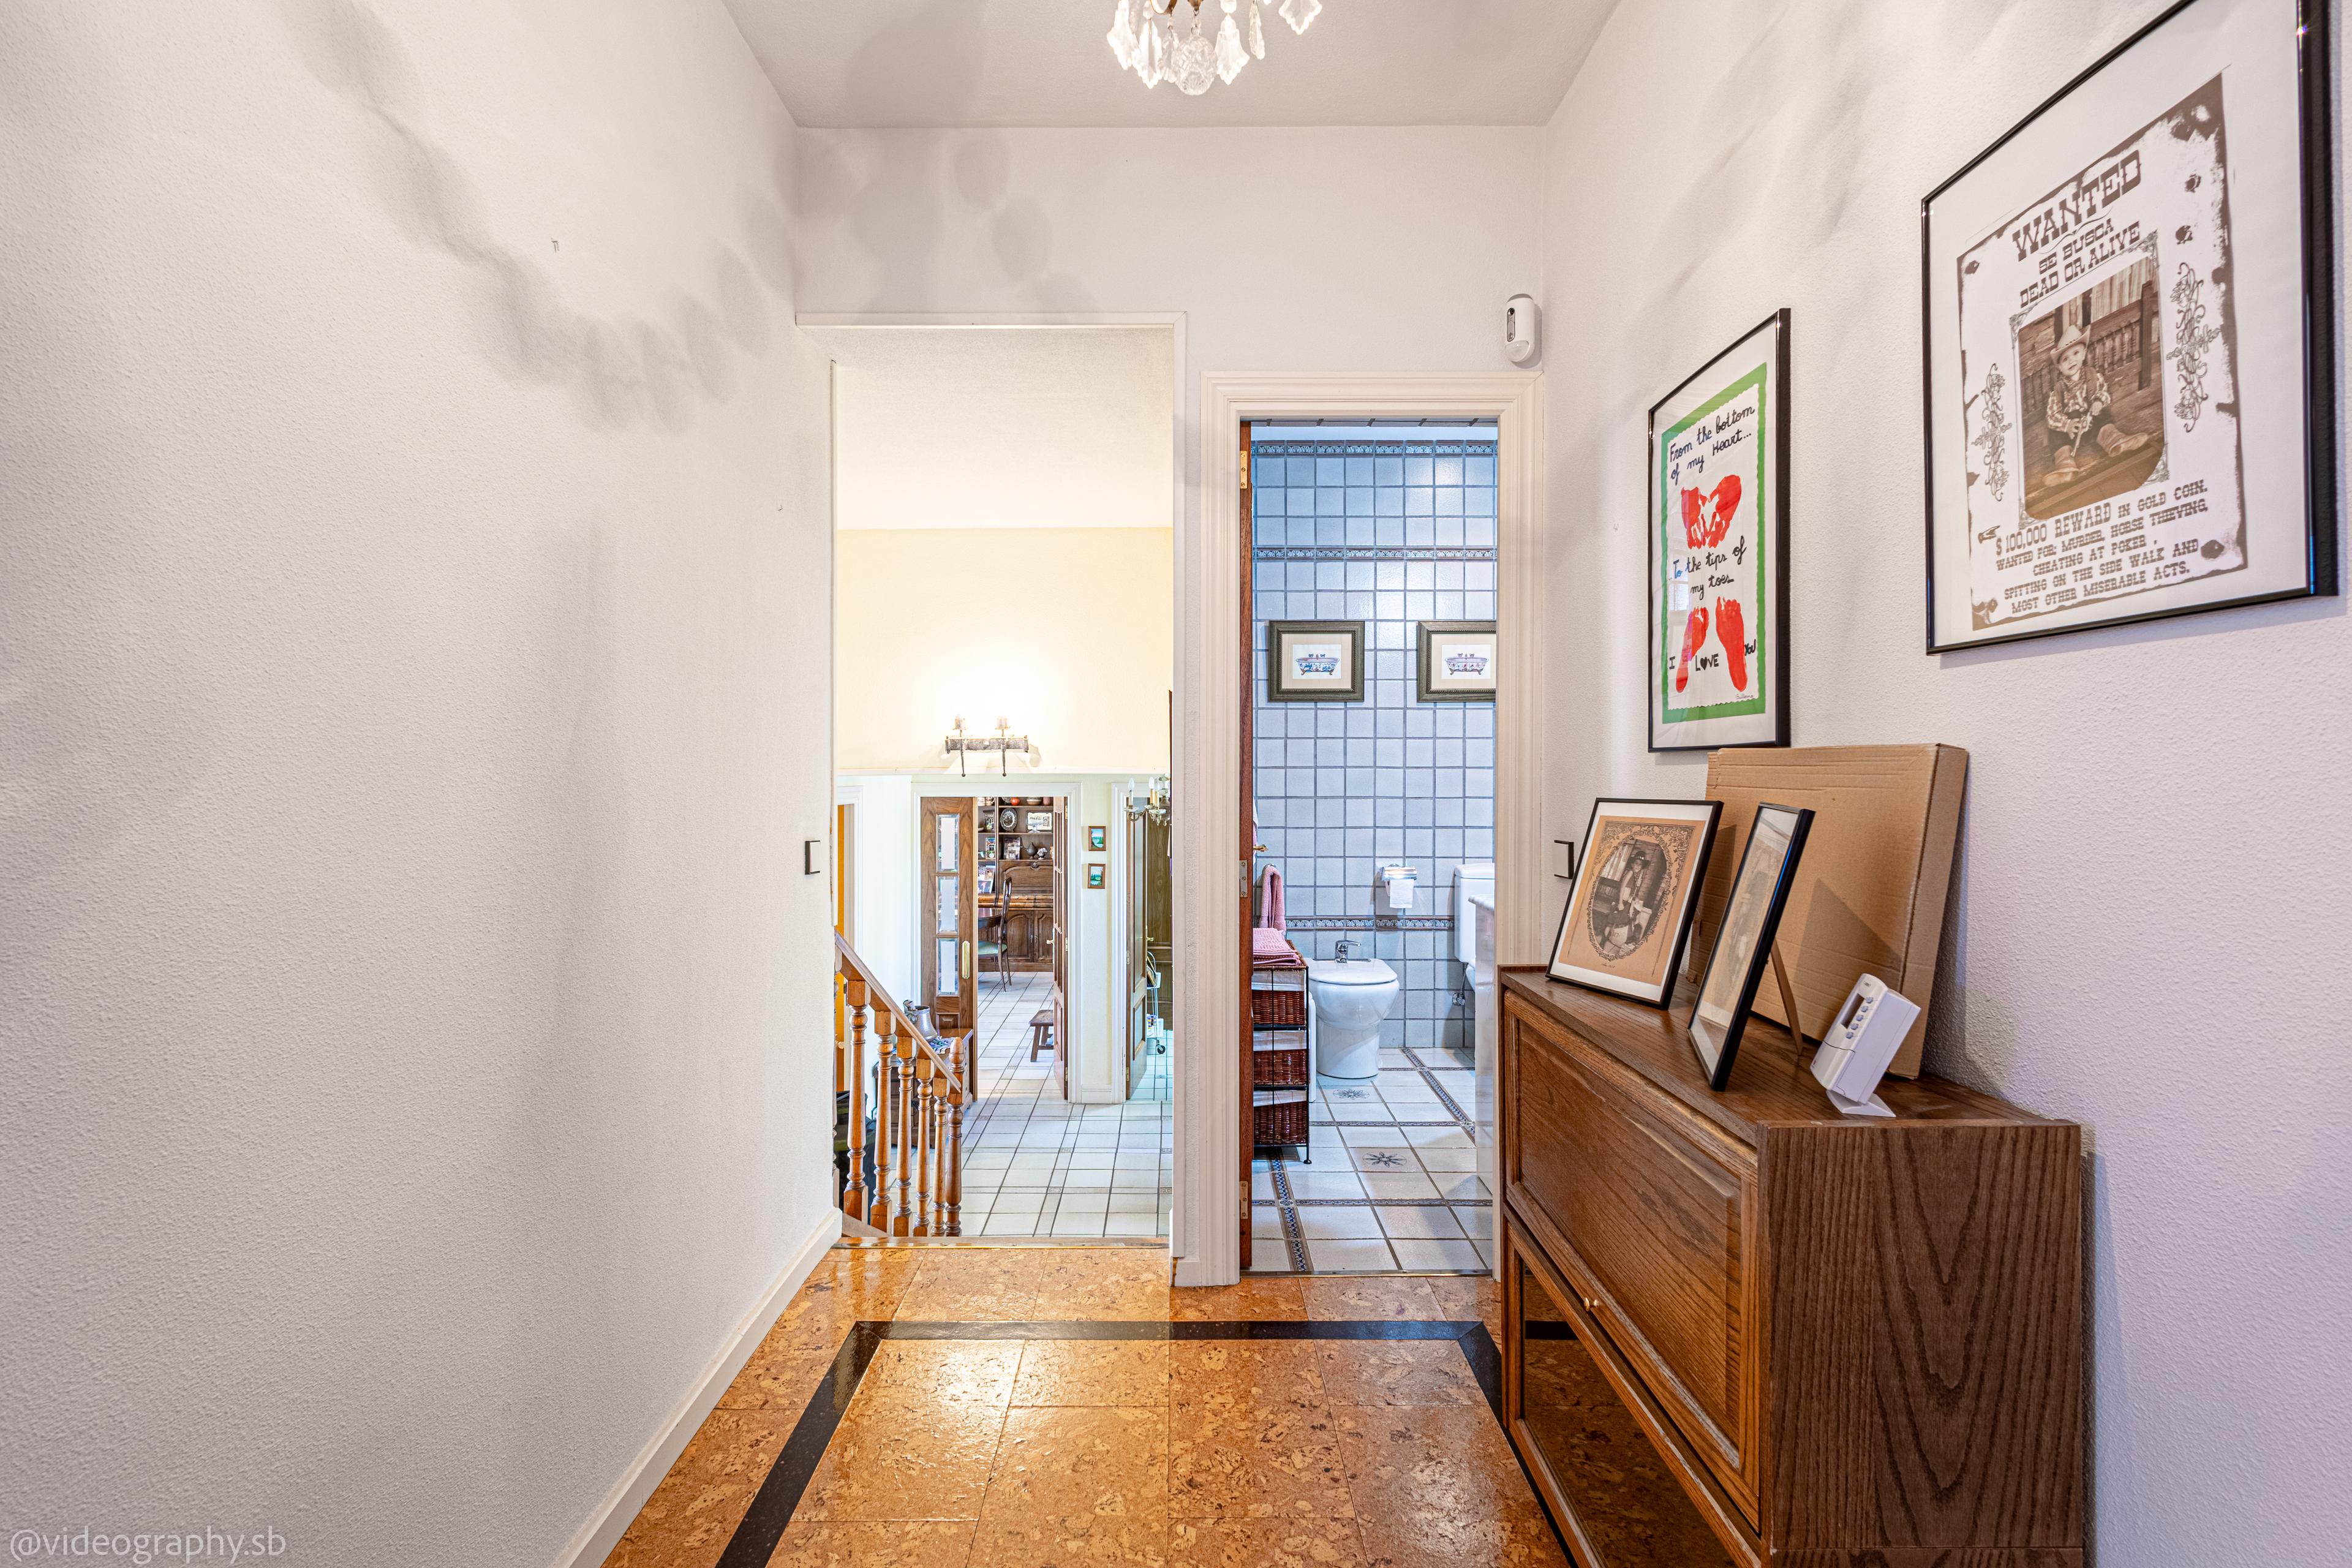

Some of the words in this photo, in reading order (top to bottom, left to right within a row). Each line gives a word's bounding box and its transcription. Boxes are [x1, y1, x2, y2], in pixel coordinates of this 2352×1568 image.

[2012, 150, 2141, 262] WANTED
[2020, 271, 2059, 308] DEAD
[2064, 257, 2085, 282] OR
[2088, 221, 2140, 269] ALIVE
[2039, 252, 2057, 274] SE
[2063, 218, 2114, 260] BUSCA
[1670, 443, 1692, 462] From
[1696, 426, 1712, 445] the
[1716, 407, 1755, 434] bottom
[1671, 463, 1679, 485] of
[1687, 455, 1704, 473] my
[2006, 524, 2047, 552] 100,000
[2055, 502, 2111, 538] REWARD
[2118, 503, 2130, 518] IN
[2138, 492, 2166, 511] GOLD
[2174, 479, 2207, 500] COIN.
[1685, 556, 1701, 573] the
[1705, 552, 1727, 570] tips
[1732, 535, 1747, 565] of
[1996, 550, 2033, 571] WANTED
[2111, 516, 2144, 538] HORSE
[2004, 579, 2047, 600] SPITTING
[2052, 573, 2066, 587] ON
[2073, 567, 2093, 582] THE
[2099, 559, 2122, 576] SIDE
[2128, 547, 2165, 568] WALK
[2173, 538, 2198, 557] AND
[2033, 552, 2082, 576] CHEATING
[2089, 546, 2105, 562] AT
[1691, 584, 1704, 600] my
[2011, 597, 2038, 614] MOST
[2045, 588, 2077, 605] OTHER
[2083, 570, 2146, 597] MISERABLE
[2154, 561, 2190, 581] ACTS.
[1669, 655, 1675, 669] I
